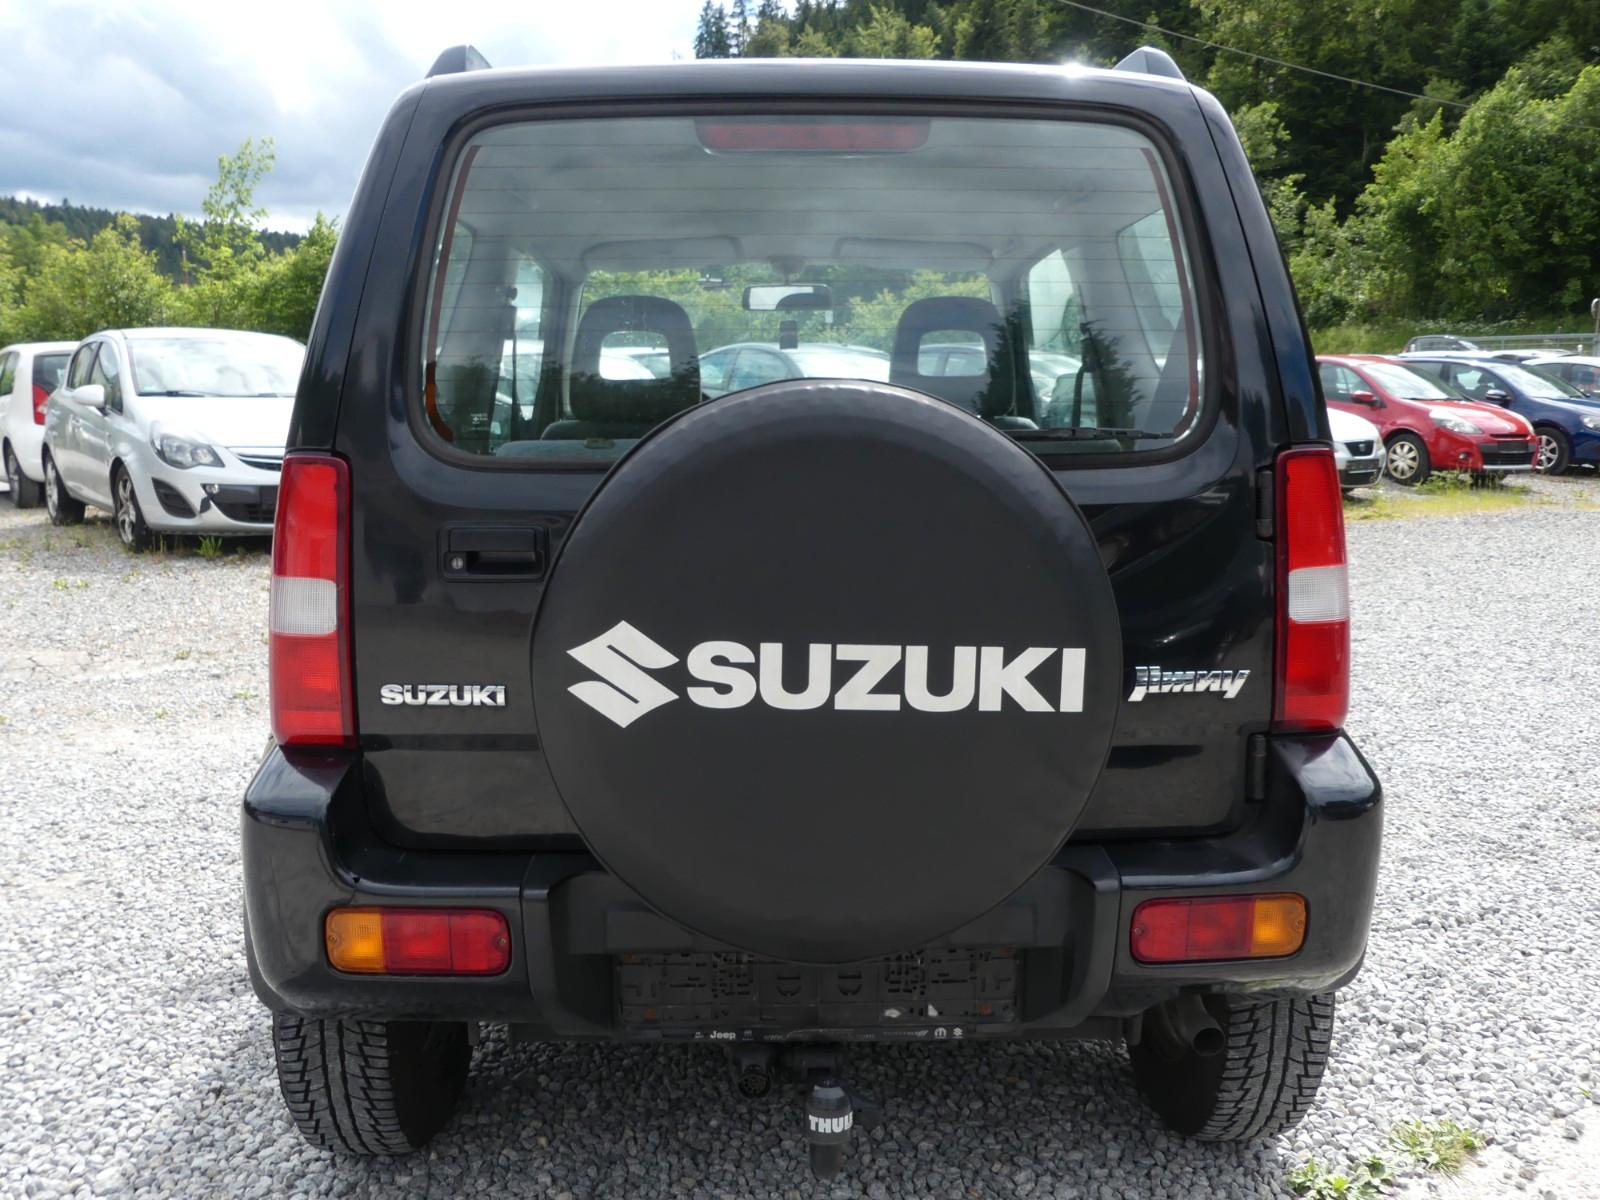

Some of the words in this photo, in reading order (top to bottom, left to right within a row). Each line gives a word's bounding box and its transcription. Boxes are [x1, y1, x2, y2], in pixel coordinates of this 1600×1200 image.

[687, 641, 1087, 713] SUZUKI
[380, 682, 506, 707] SUZUKI
[709, 1030, 736, 1040] Jeep
